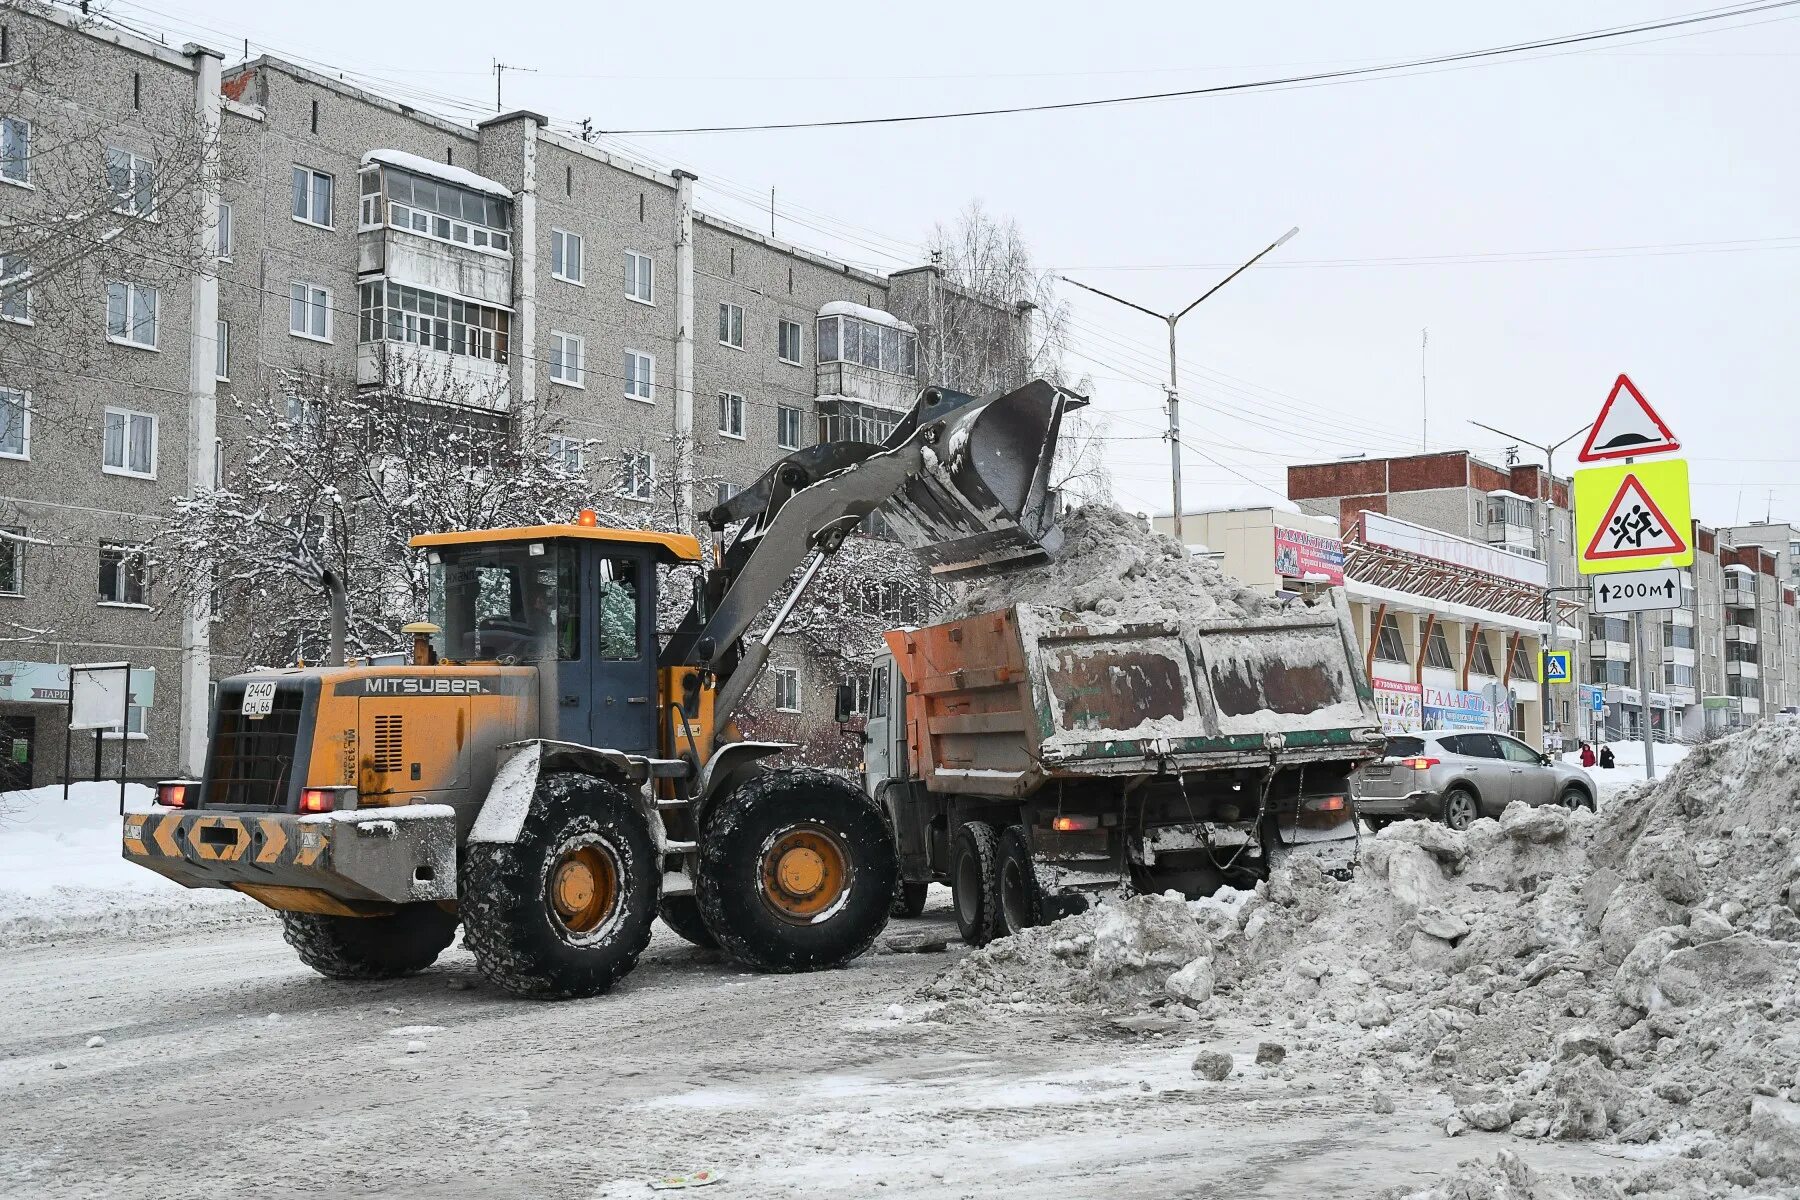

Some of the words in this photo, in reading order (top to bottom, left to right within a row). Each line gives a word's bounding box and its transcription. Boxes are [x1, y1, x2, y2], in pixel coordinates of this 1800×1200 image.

[1277, 528, 1343, 554] ГАЛАКТИКА
[248, 684, 272, 697] 2440
[245, 702, 256, 712] СН
[260, 702, 270, 712] 66
[1594, 693, 1601, 708] P
